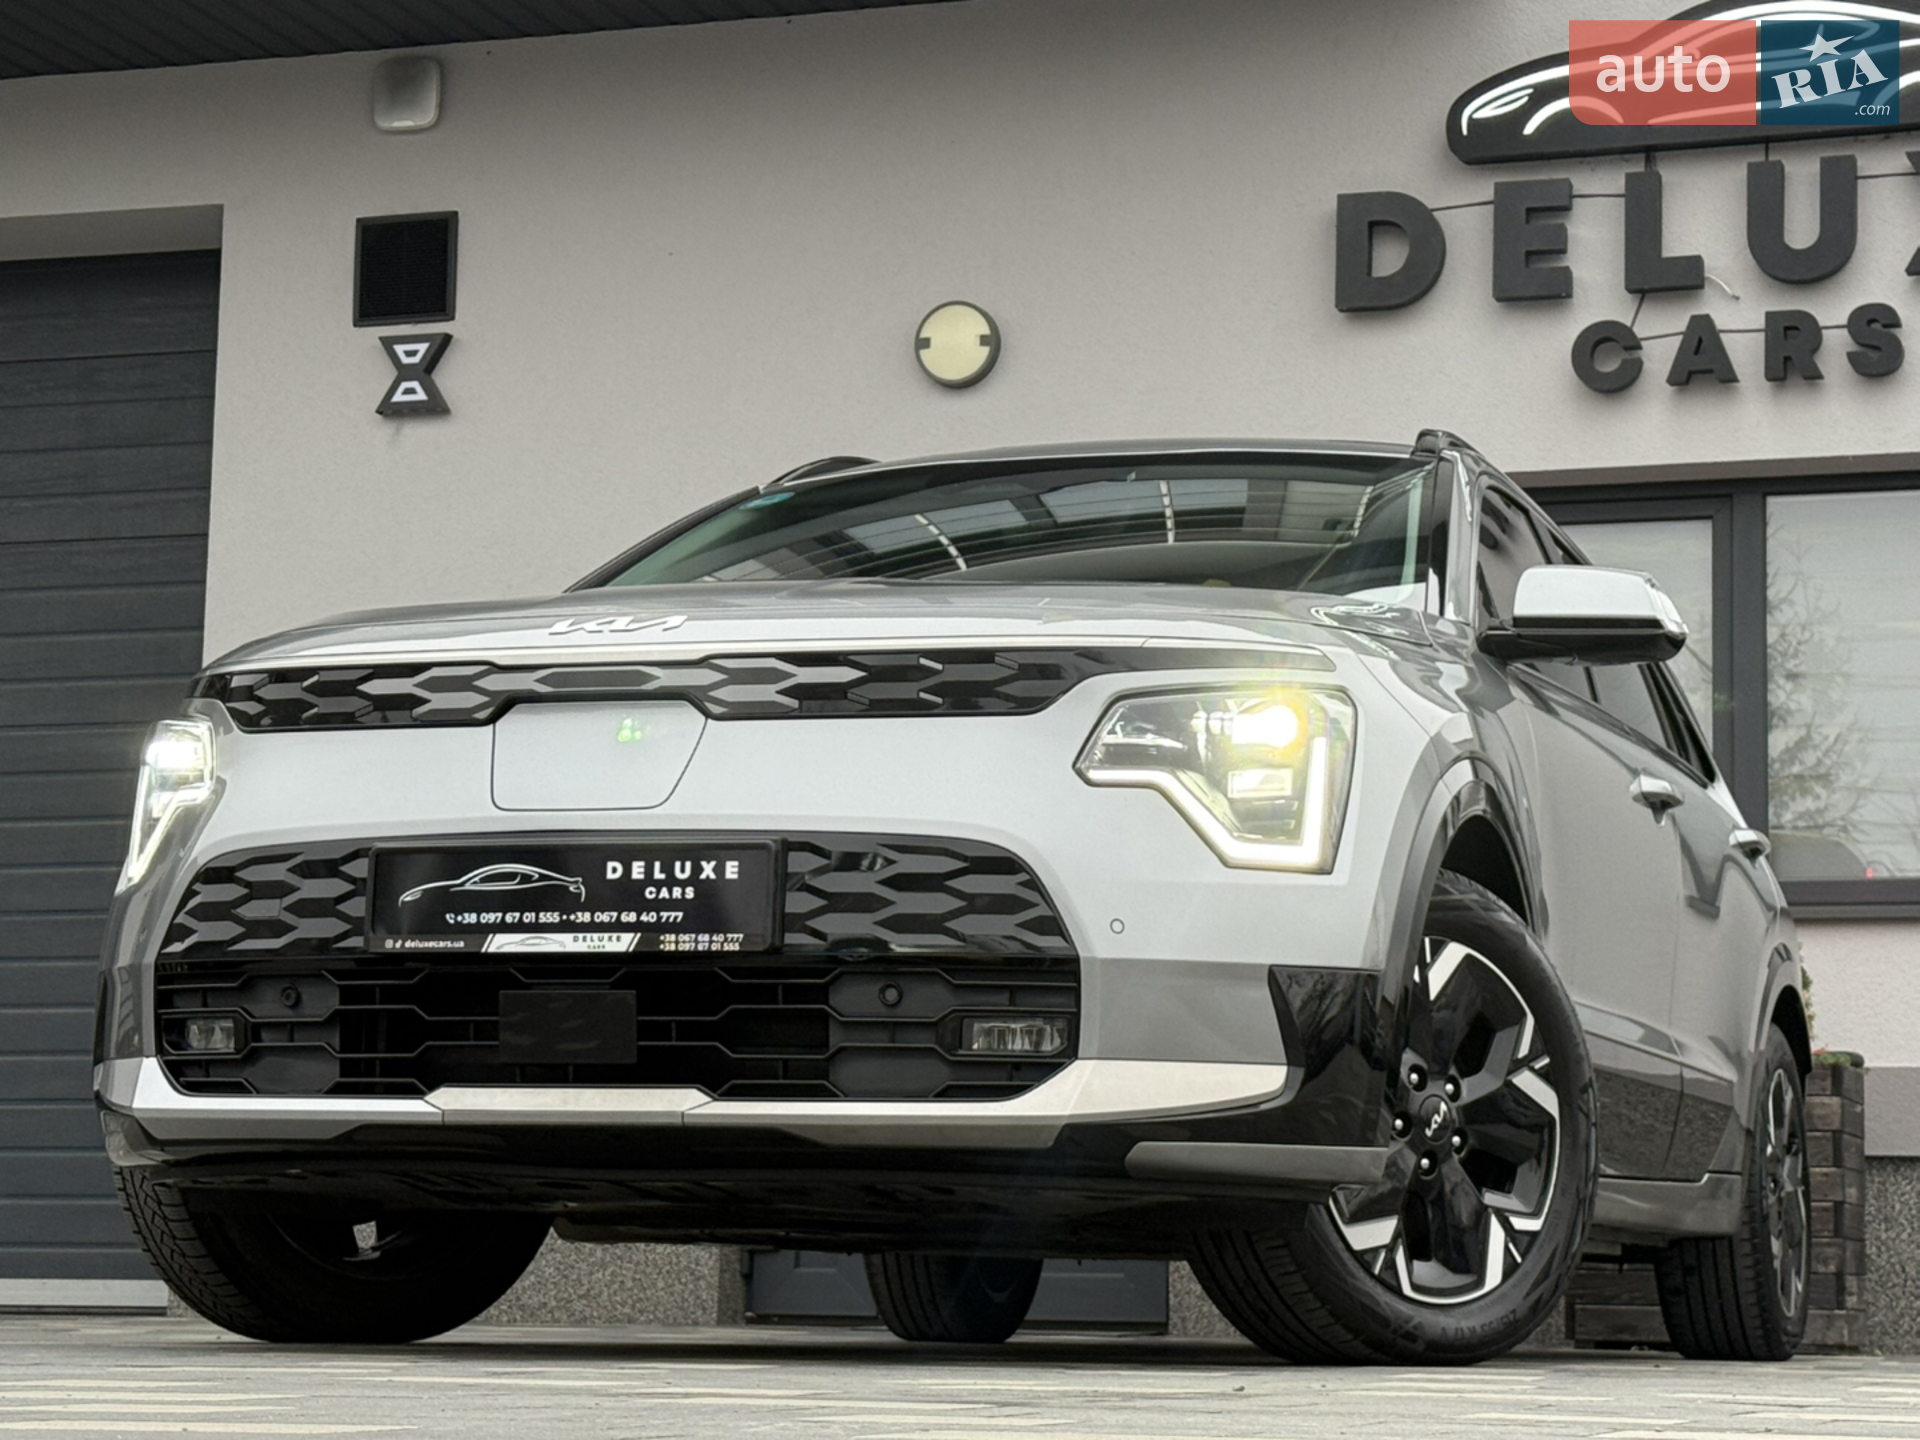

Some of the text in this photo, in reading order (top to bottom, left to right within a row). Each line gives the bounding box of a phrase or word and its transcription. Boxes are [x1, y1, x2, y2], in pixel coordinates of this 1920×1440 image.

[1571, 303, 1905, 393] CARS
[606, 860, 739, 880] DELUXE
[644, 886, 695, 899] CARS
[456, 911, 684, 924] +38 097 67 01 555 +38 067 68 40 777
